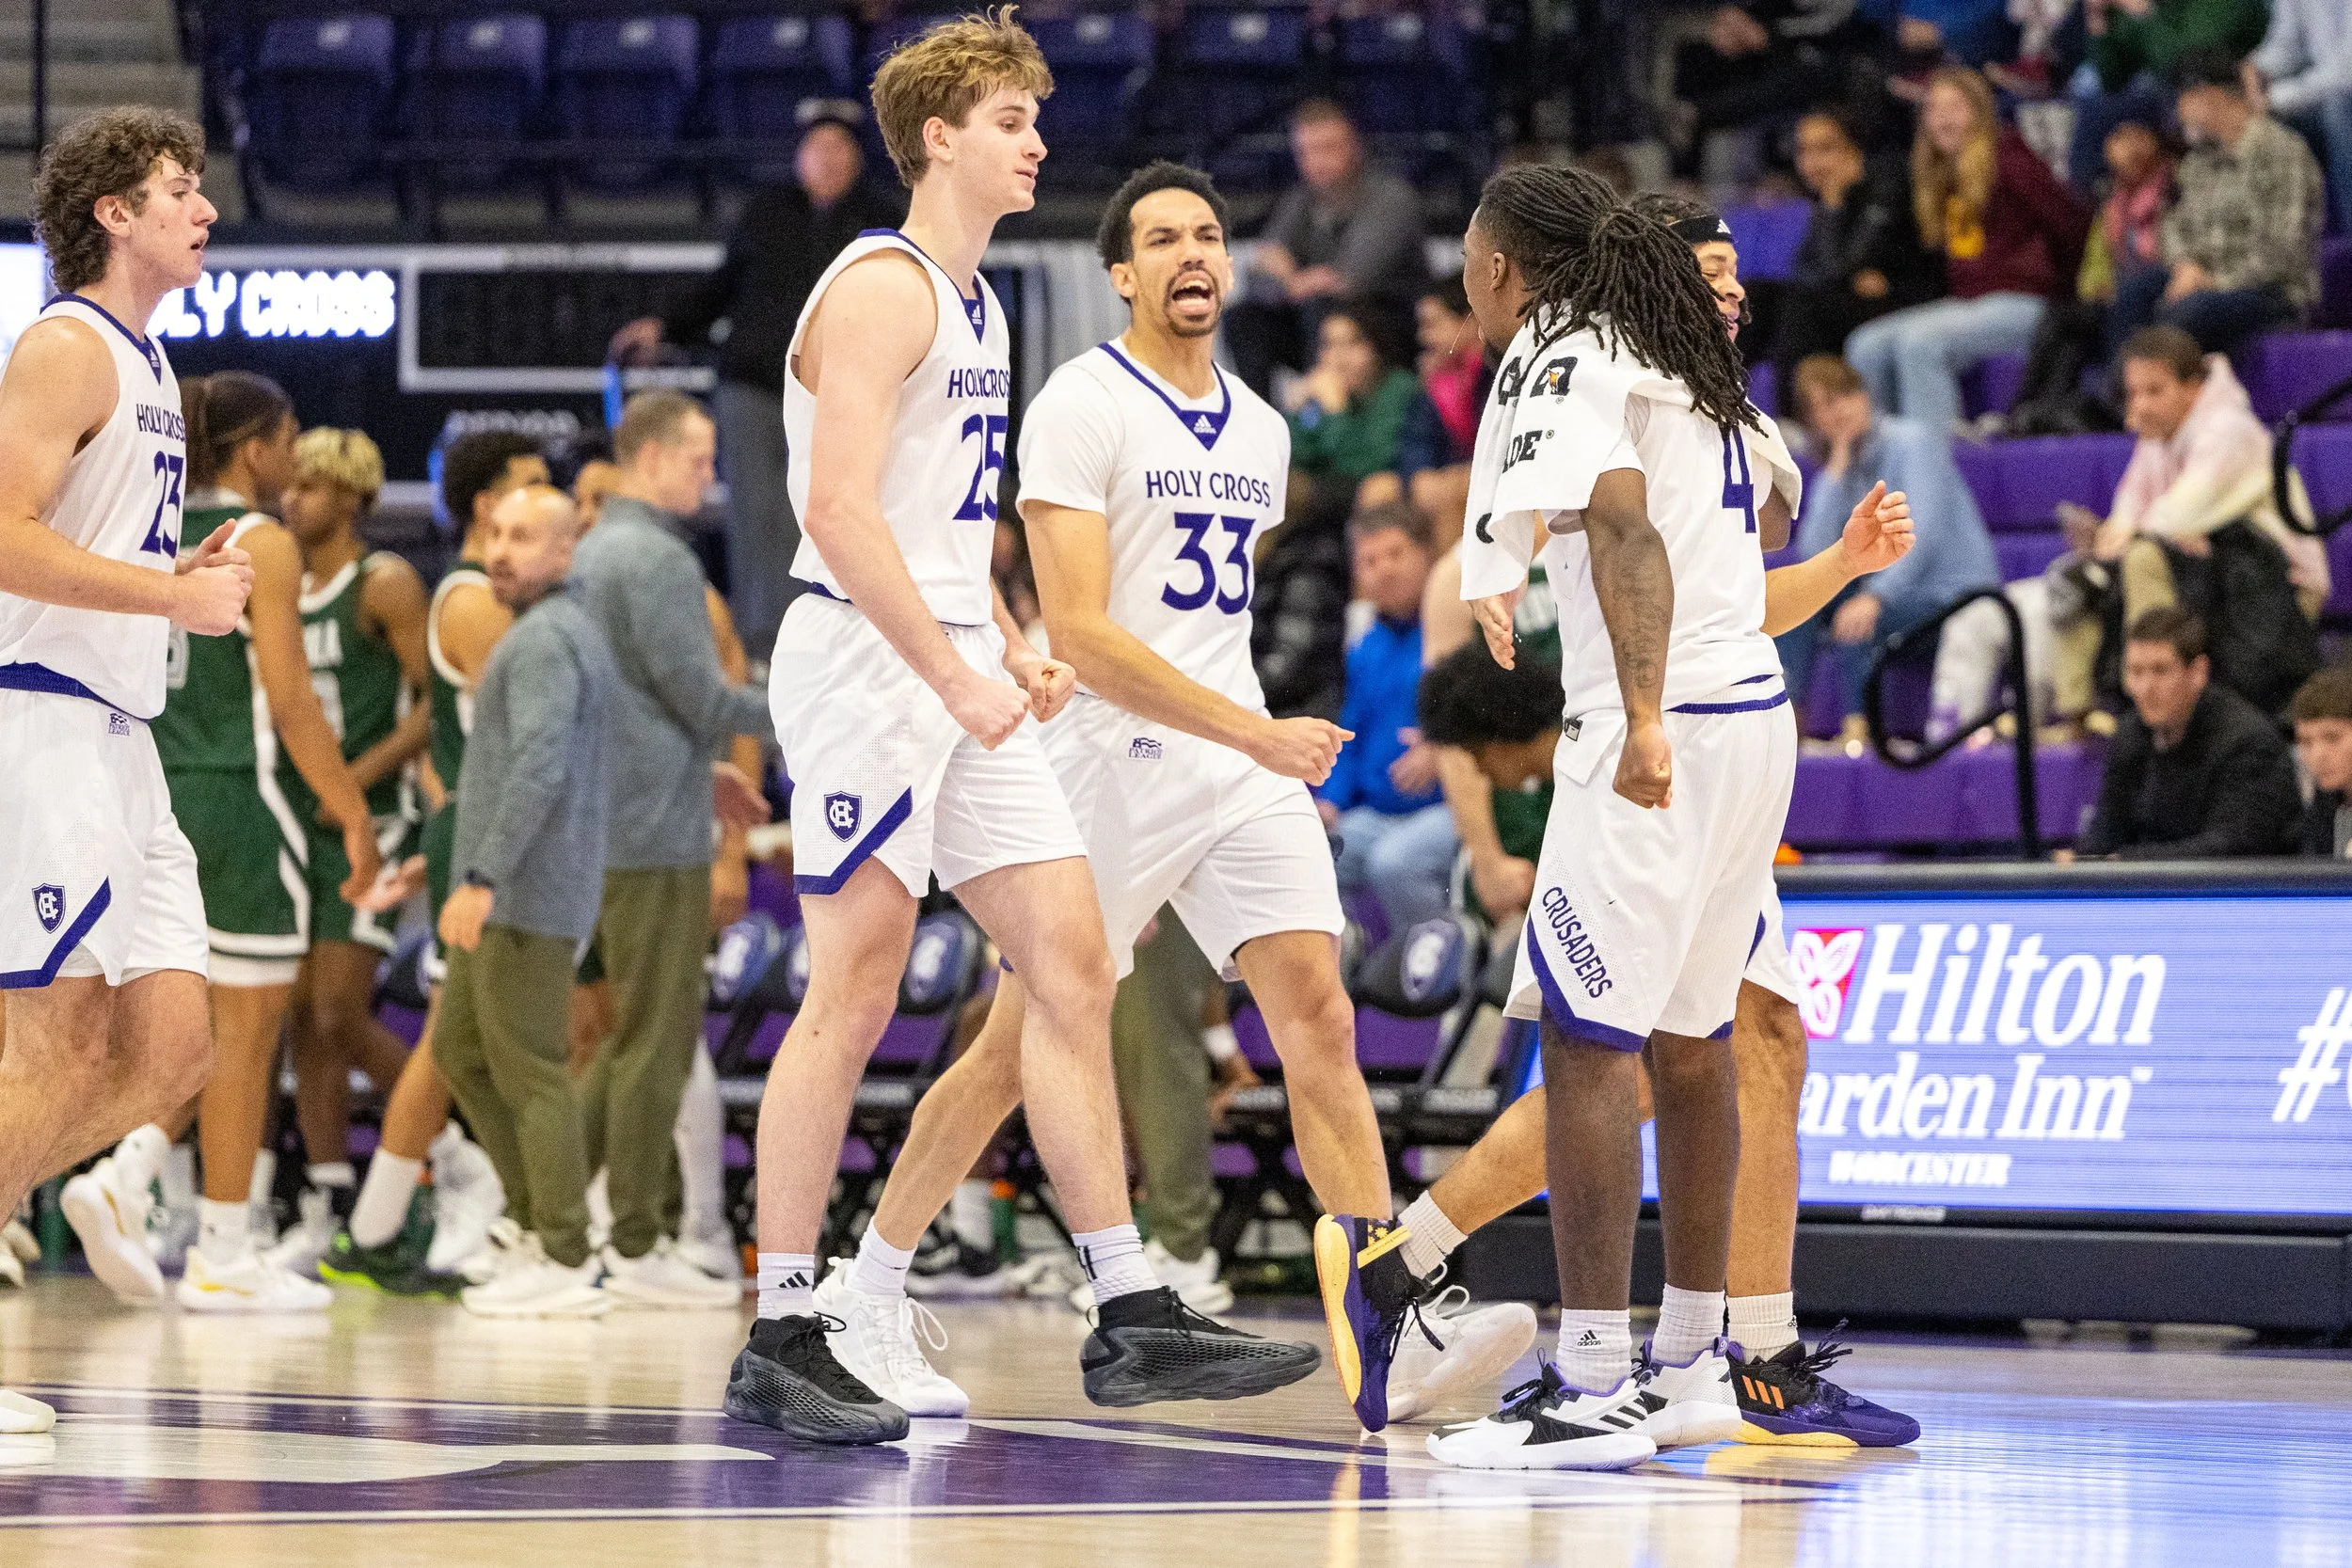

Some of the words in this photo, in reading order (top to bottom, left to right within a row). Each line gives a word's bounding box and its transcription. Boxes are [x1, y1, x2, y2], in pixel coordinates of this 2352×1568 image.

[144, 271, 236, 338] LY
[241, 270, 395, 338] CROSS
[136, 404, 162, 435] HOLY
[947, 368, 983, 398] HOLY
[983, 368, 1009, 398] CROS
[952, 414, 1009, 521] 25
[1146, 470, 1201, 498] HOLY
[1210, 472, 1271, 508] CROSS
[1502, 430, 1543, 473] DE
[1722, 423, 1756, 533] 4
[139, 451, 184, 559] 23
[1161, 512, 1256, 615] 33
[1543, 887, 1613, 998] CRUSADERS
[1843, 923, 2166, 1047] Hilton
[1798, 1052, 1995, 1140] arden
[1995, 1053, 2134, 1140] Inn
[1829, 1150, 2012, 1187] WORCESTER
